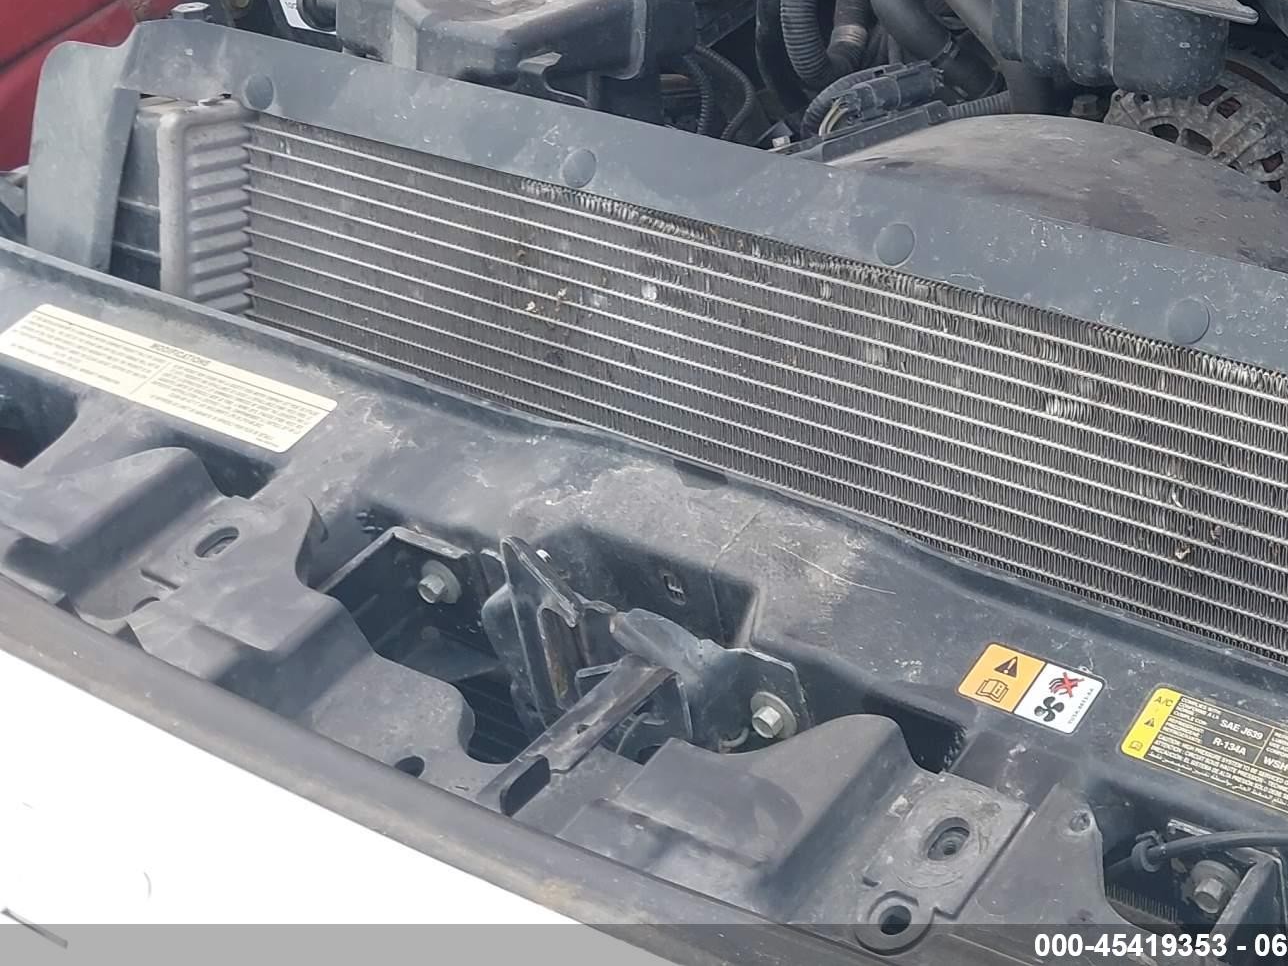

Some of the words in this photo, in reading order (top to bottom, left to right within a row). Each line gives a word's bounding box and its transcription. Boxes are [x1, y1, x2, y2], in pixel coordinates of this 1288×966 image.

[1154, 695, 1174, 708] A/C
[1219, 719, 1240, 731] SAE
[1240, 727, 1263, 739] J639
[1212, 737, 1247, 754] R-134A
